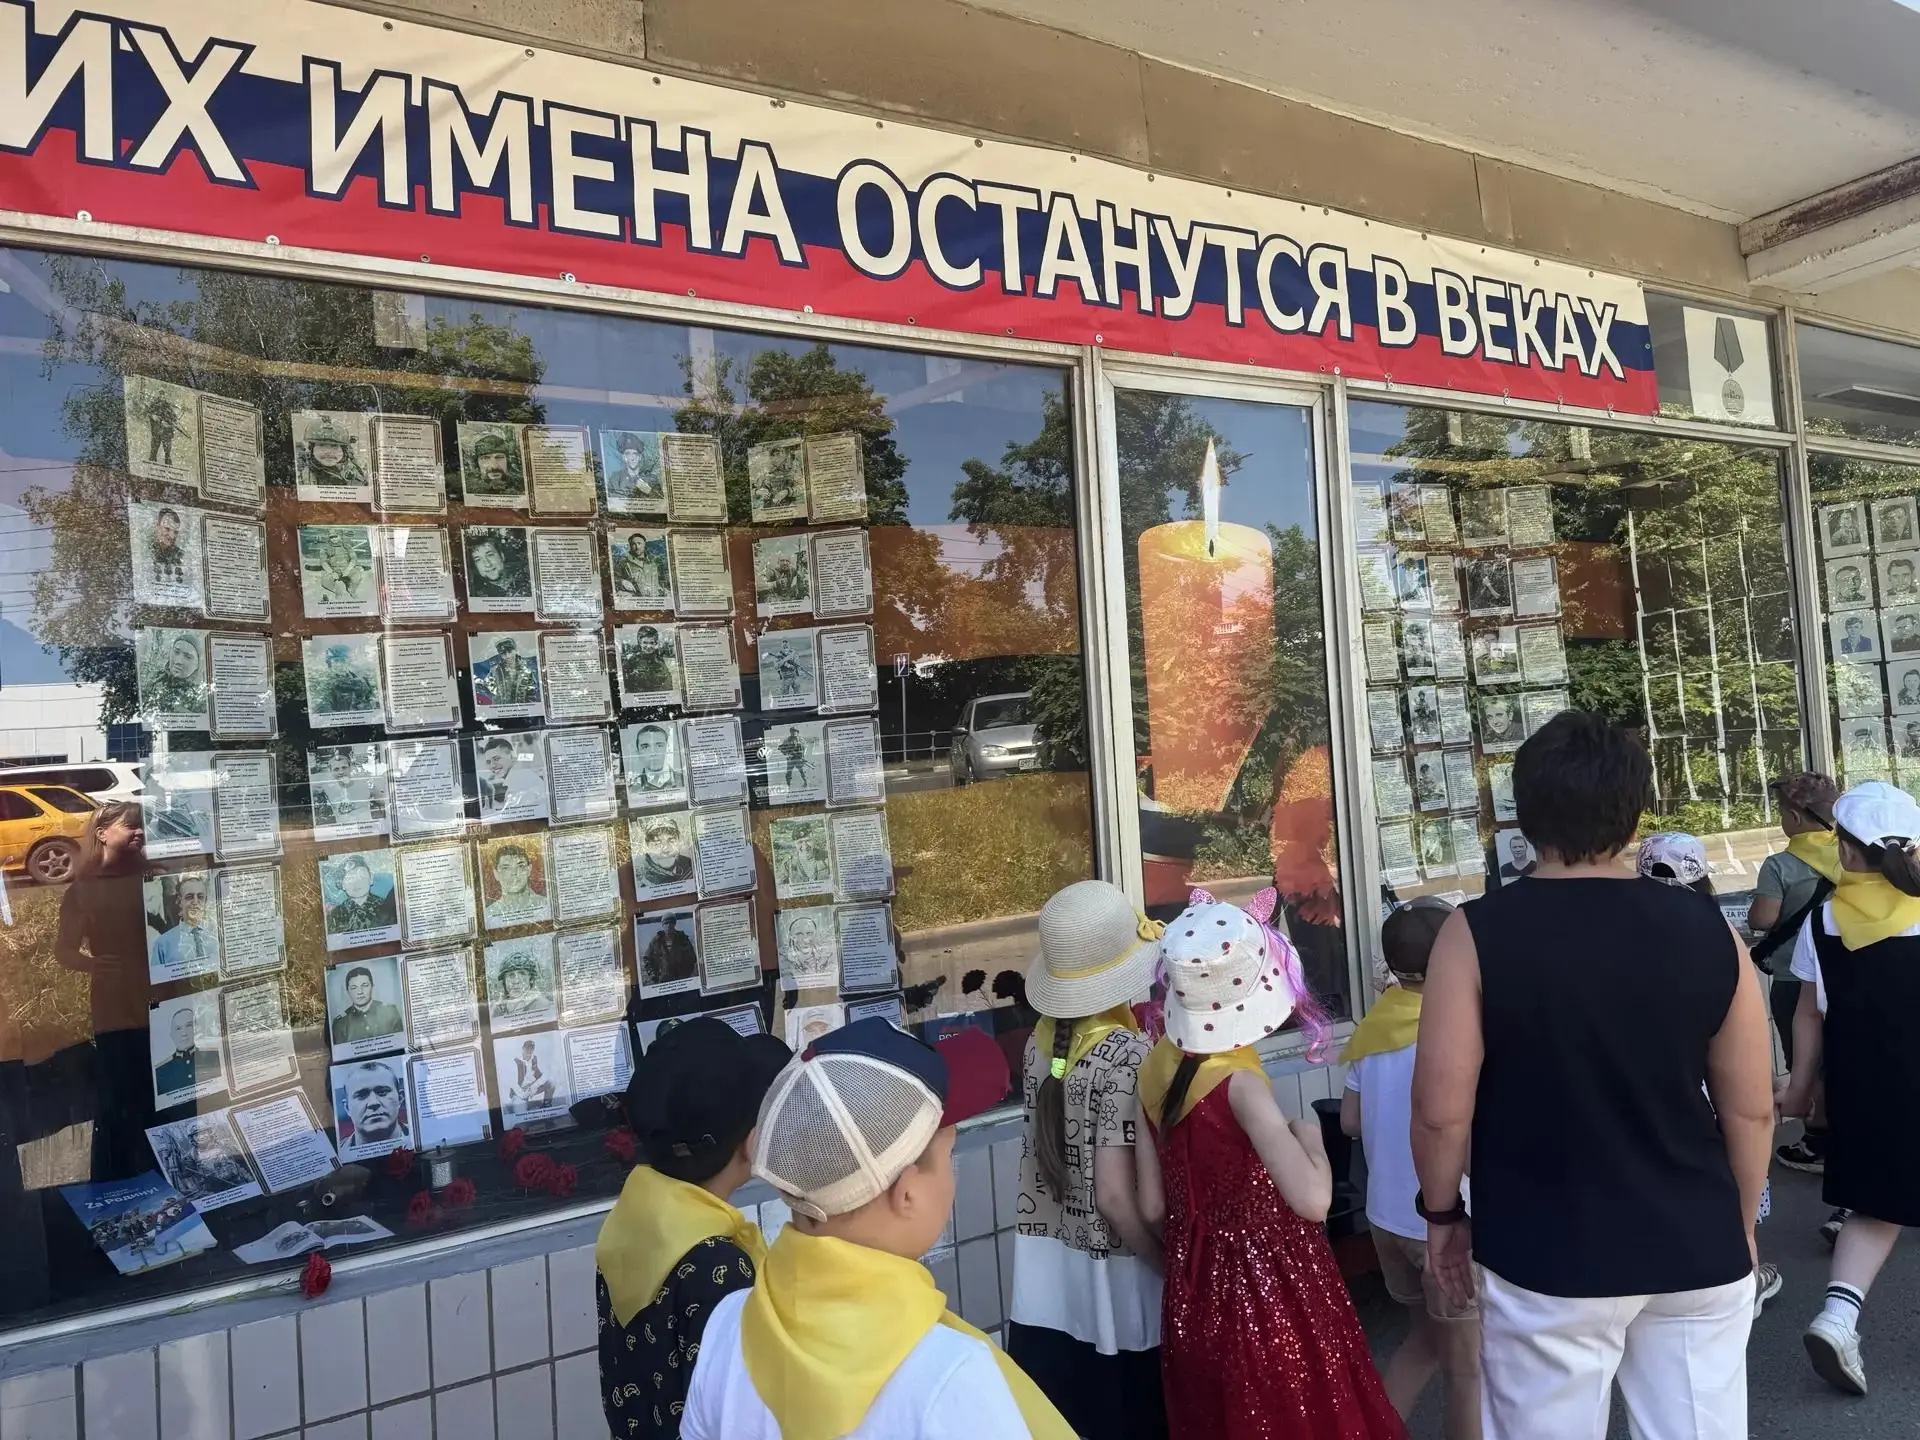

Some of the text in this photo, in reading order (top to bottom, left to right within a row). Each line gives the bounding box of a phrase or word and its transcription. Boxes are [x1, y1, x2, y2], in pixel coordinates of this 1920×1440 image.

[0, 0, 1628, 382] ИХ ИМЕНА ОСТАНУТСЯ В ВЕКАХ
